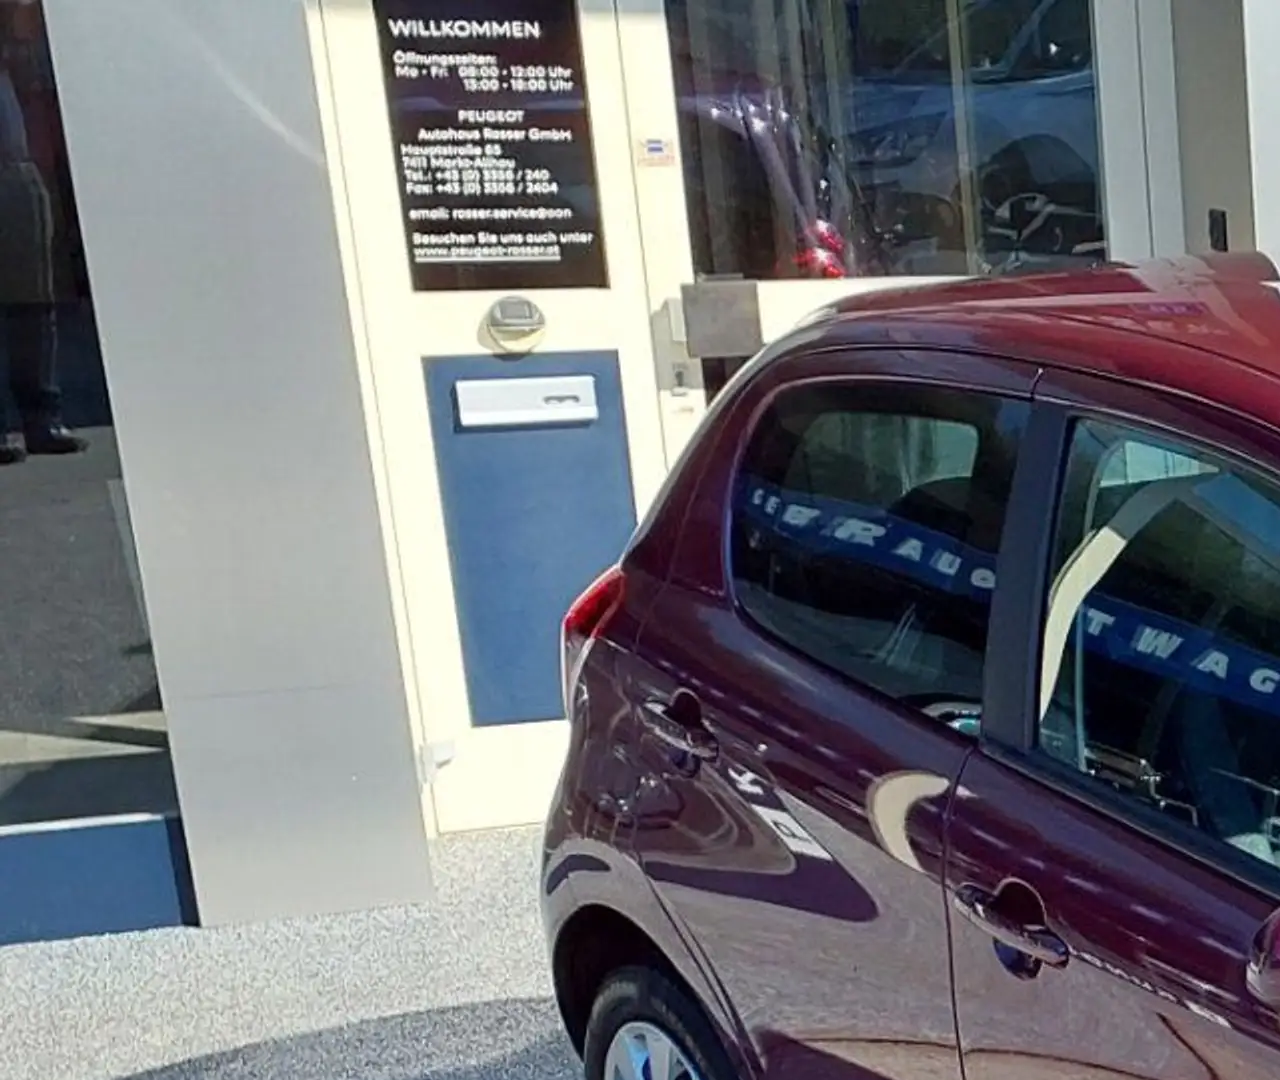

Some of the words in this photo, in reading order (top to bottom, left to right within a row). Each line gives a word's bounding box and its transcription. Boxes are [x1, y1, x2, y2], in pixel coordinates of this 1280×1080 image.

[388, 18, 541, 39] WILLKOMMEN
[393, 50, 497, 66] Öffnungszeiten:
[395, 66, 419, 78] Mo
[458, 66, 499, 78] 08:00
[510, 66, 546, 78] 12:00
[548, 66, 573, 78] Uhr
[549, 79, 574, 91] Uhr
[458, 110, 525, 122] PEUGEOT
[418, 128, 481, 141] Autohaus
[483, 128, 526, 141] Rasser
[528, 128, 572, 142] GmbH
[401, 144, 482, 156] Hauptstraße
[436, 170, 459, 181] +43
[525, 170, 550, 180] 240
[437, 182, 460, 194] +43
[526, 182, 559, 194] 2404
[409, 207, 449, 219] email:
[413, 232, 475, 245] Besuchen
[478, 231, 497, 244] Sie
[500, 233, 523, 244] uns
[526, 231, 557, 244] auch
[560, 232, 593, 244] unter
